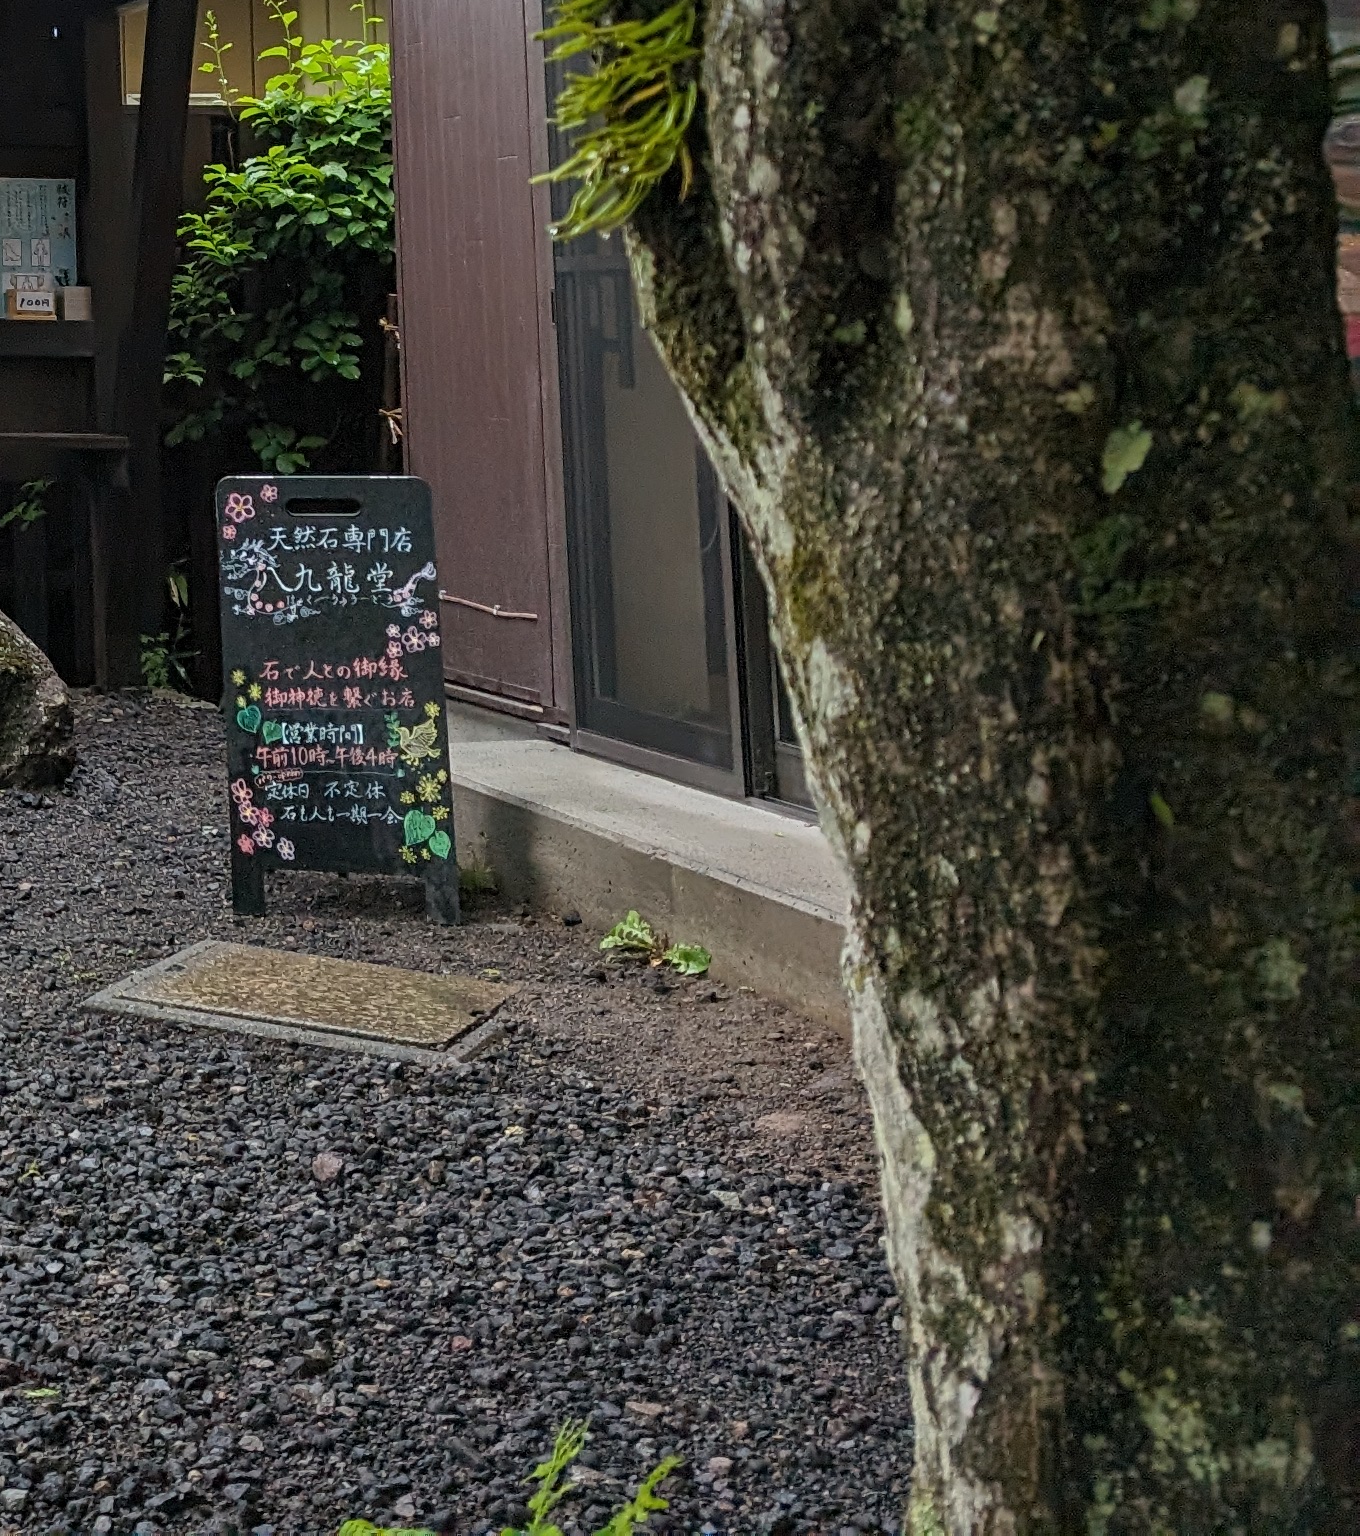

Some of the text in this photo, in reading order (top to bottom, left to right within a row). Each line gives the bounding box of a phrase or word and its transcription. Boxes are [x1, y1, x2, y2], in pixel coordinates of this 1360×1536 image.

[20, 297, 50, 308] 100円
[268, 524, 413, 553] 天然石専門店
[257, 561, 393, 593] 八九龍堂
[260, 656, 409, 681] 石で人との御縁
[265, 686, 415, 709] 御神徳を繋ぐお店
[265, 780, 386, 800] 定休日 不定休
[280, 803, 405, 825] 石も人も一期一会
